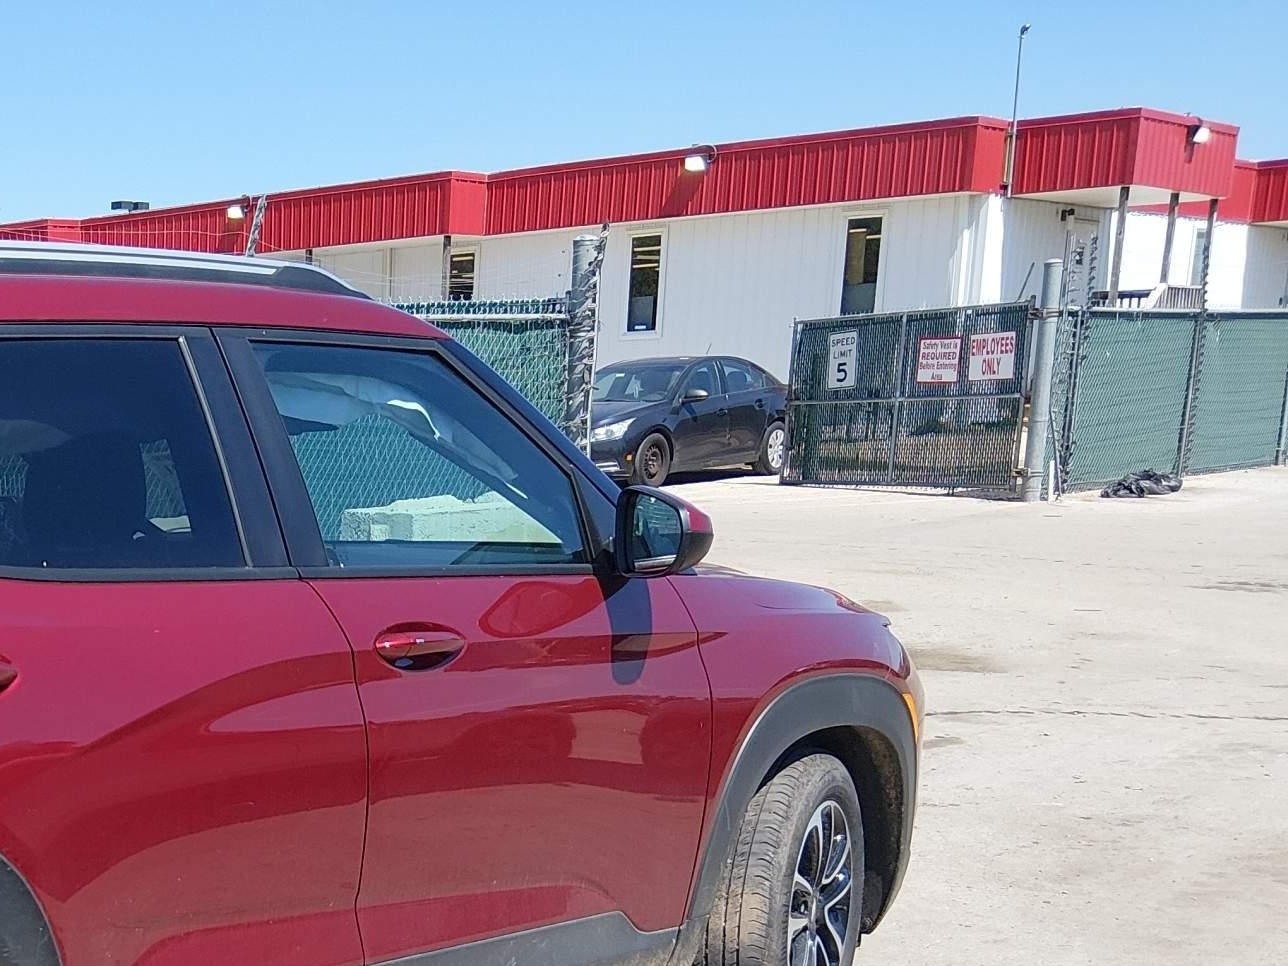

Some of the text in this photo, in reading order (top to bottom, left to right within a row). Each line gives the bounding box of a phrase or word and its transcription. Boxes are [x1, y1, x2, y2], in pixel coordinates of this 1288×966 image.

[831, 336, 856, 348] SPEED
[923, 341, 938, 352] Safety
[940, 341, 952, 350] Vest
[971, 336, 1015, 356] EMPLOYEES
[833, 349, 853, 360] LIMIT
[921, 351, 957, 361] REQUIRED
[919, 361, 957, 372] Before Entering
[981, 357, 1002, 376] ONLY
[836, 362, 848, 383] 5
[931, 372, 943, 381] Area
